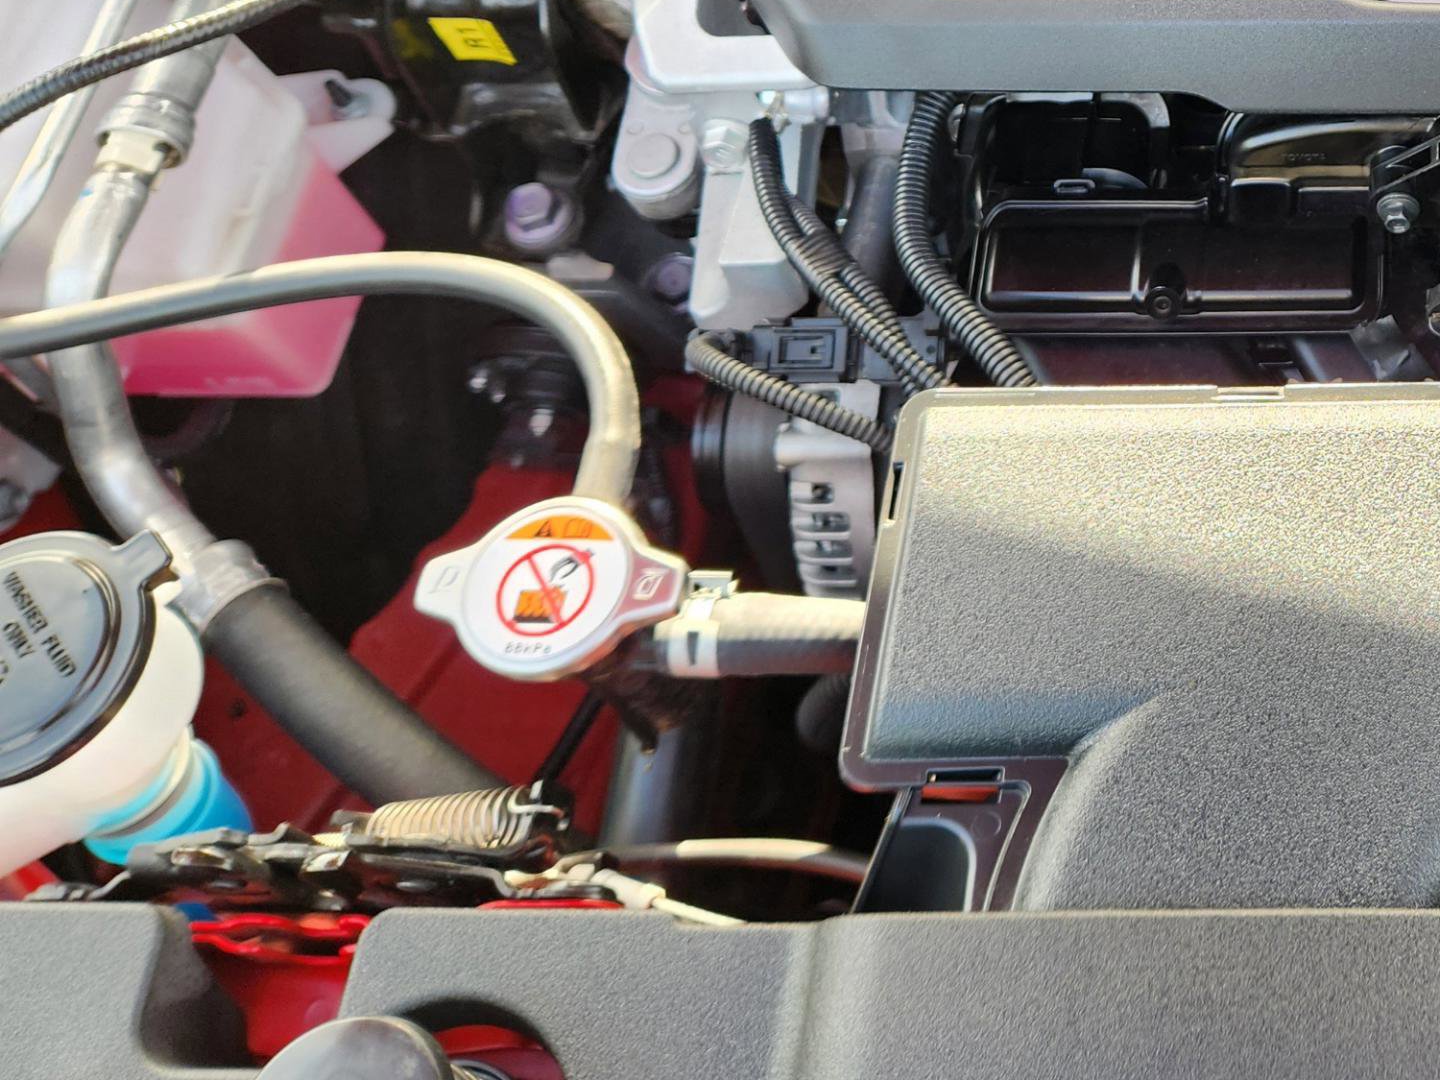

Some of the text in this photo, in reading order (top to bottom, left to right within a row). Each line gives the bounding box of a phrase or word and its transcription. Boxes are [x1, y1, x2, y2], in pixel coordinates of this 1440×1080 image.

[3, 571, 77, 677] WASHER FLUID
[3, 621, 36, 659] ONLY
